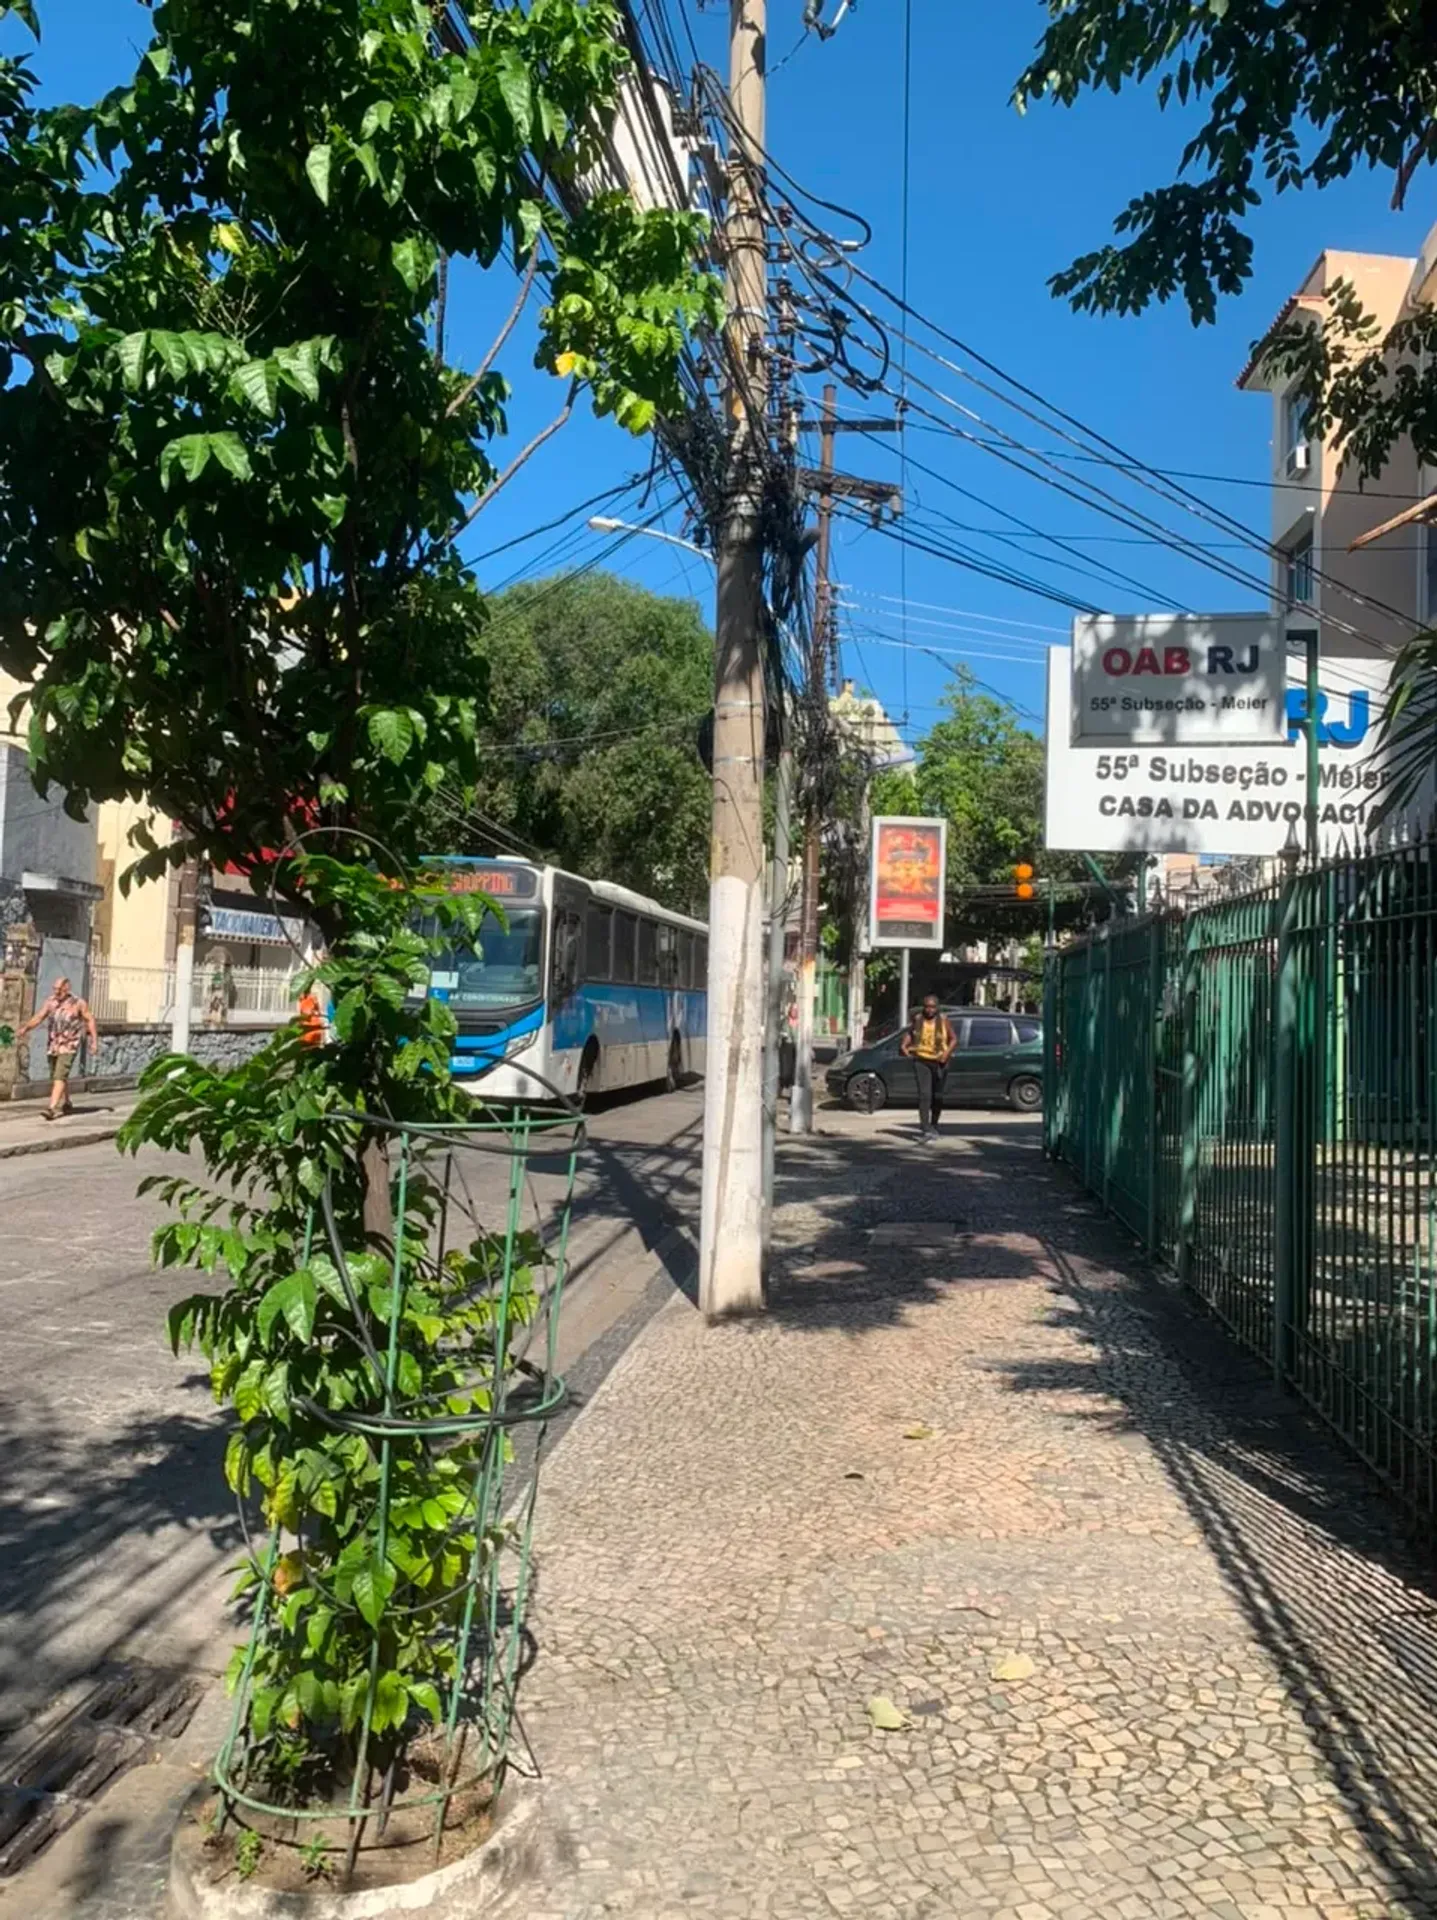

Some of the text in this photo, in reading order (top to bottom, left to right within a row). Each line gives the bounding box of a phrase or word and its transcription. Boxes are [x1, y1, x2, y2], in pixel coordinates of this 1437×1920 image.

[1102, 645, 1260, 677] OAB RJ
[1090, 696, 1117, 711] 55ª
[1121, 695, 1206, 714] Subseção
[1095, 754, 1140, 780] 55ª
[1148, 756, 1288, 791] Subseção
[1296, 773, 1306, 782] -
[1098, 795, 1174, 818] CASA
[1183, 798, 1219, 820] DA
